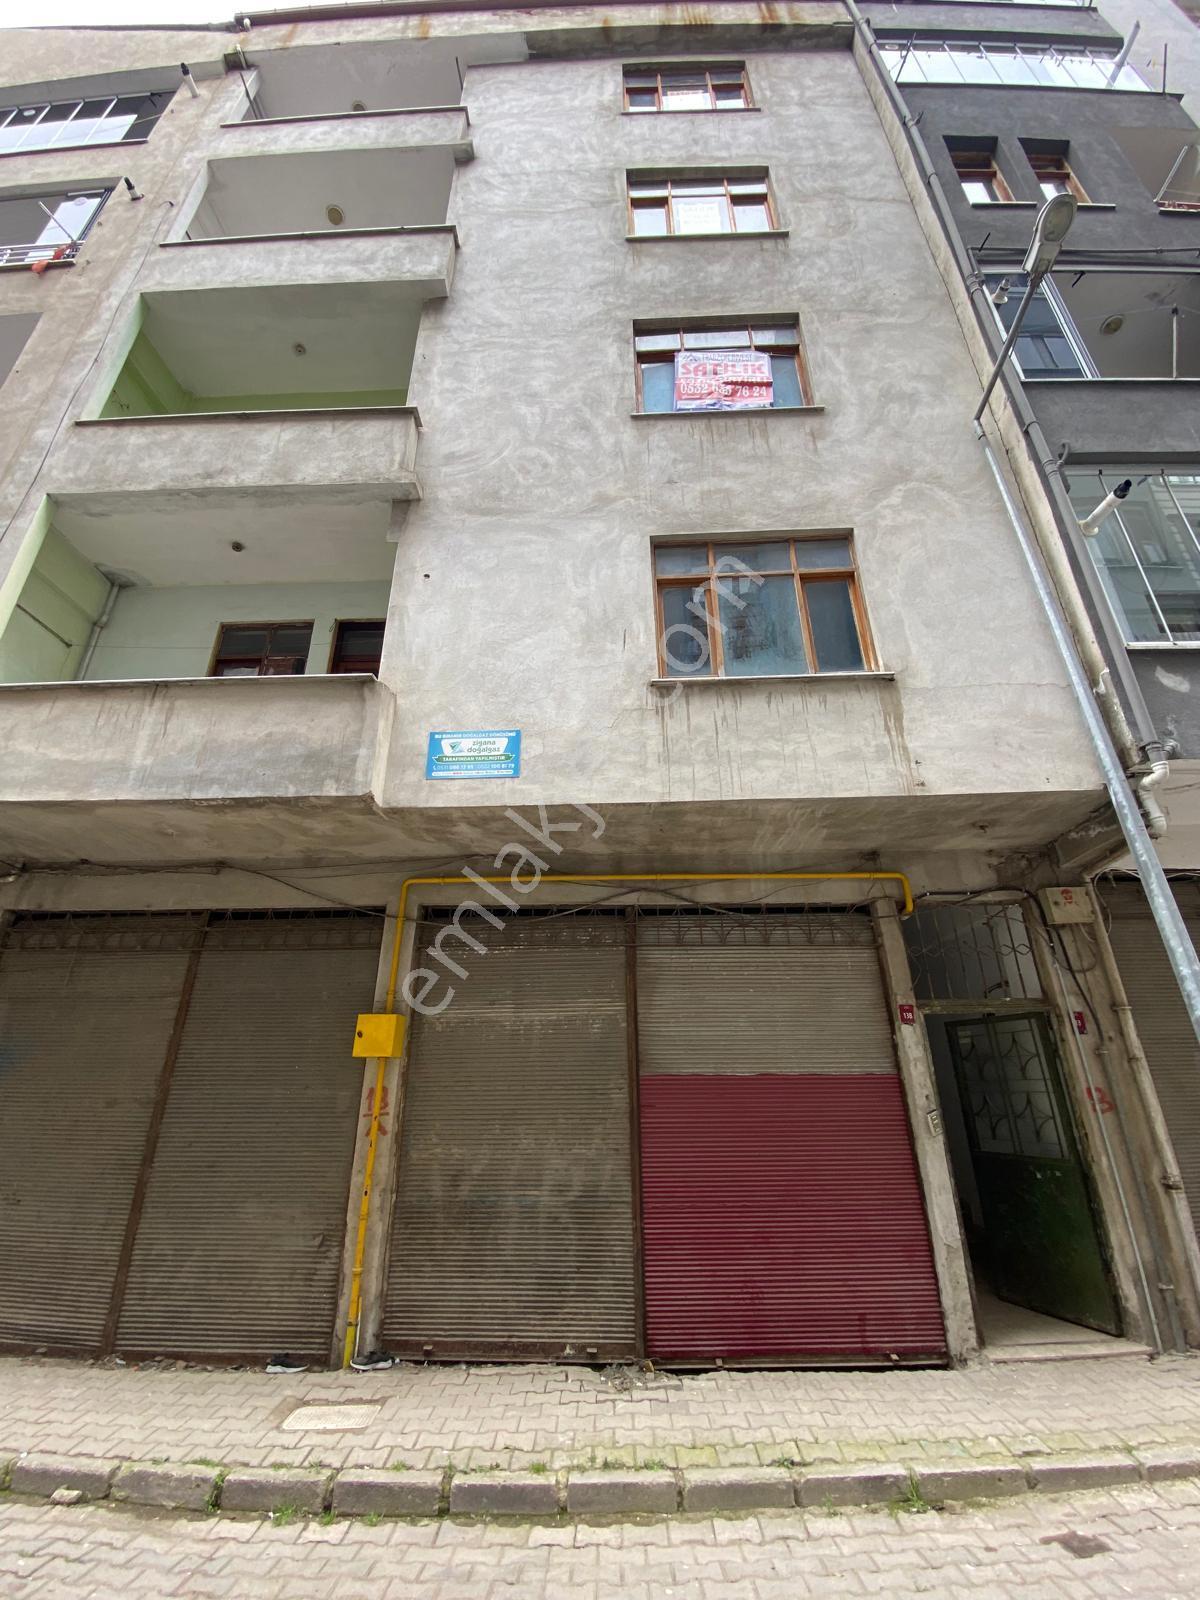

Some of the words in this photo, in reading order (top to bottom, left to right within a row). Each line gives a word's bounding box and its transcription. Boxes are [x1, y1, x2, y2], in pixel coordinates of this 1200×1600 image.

[680, 362, 766, 377] SATILIK
[752, 385, 768, 398] 24
[472, 739, 496, 747] zigana
[467, 746, 501, 754] doğalgaz
